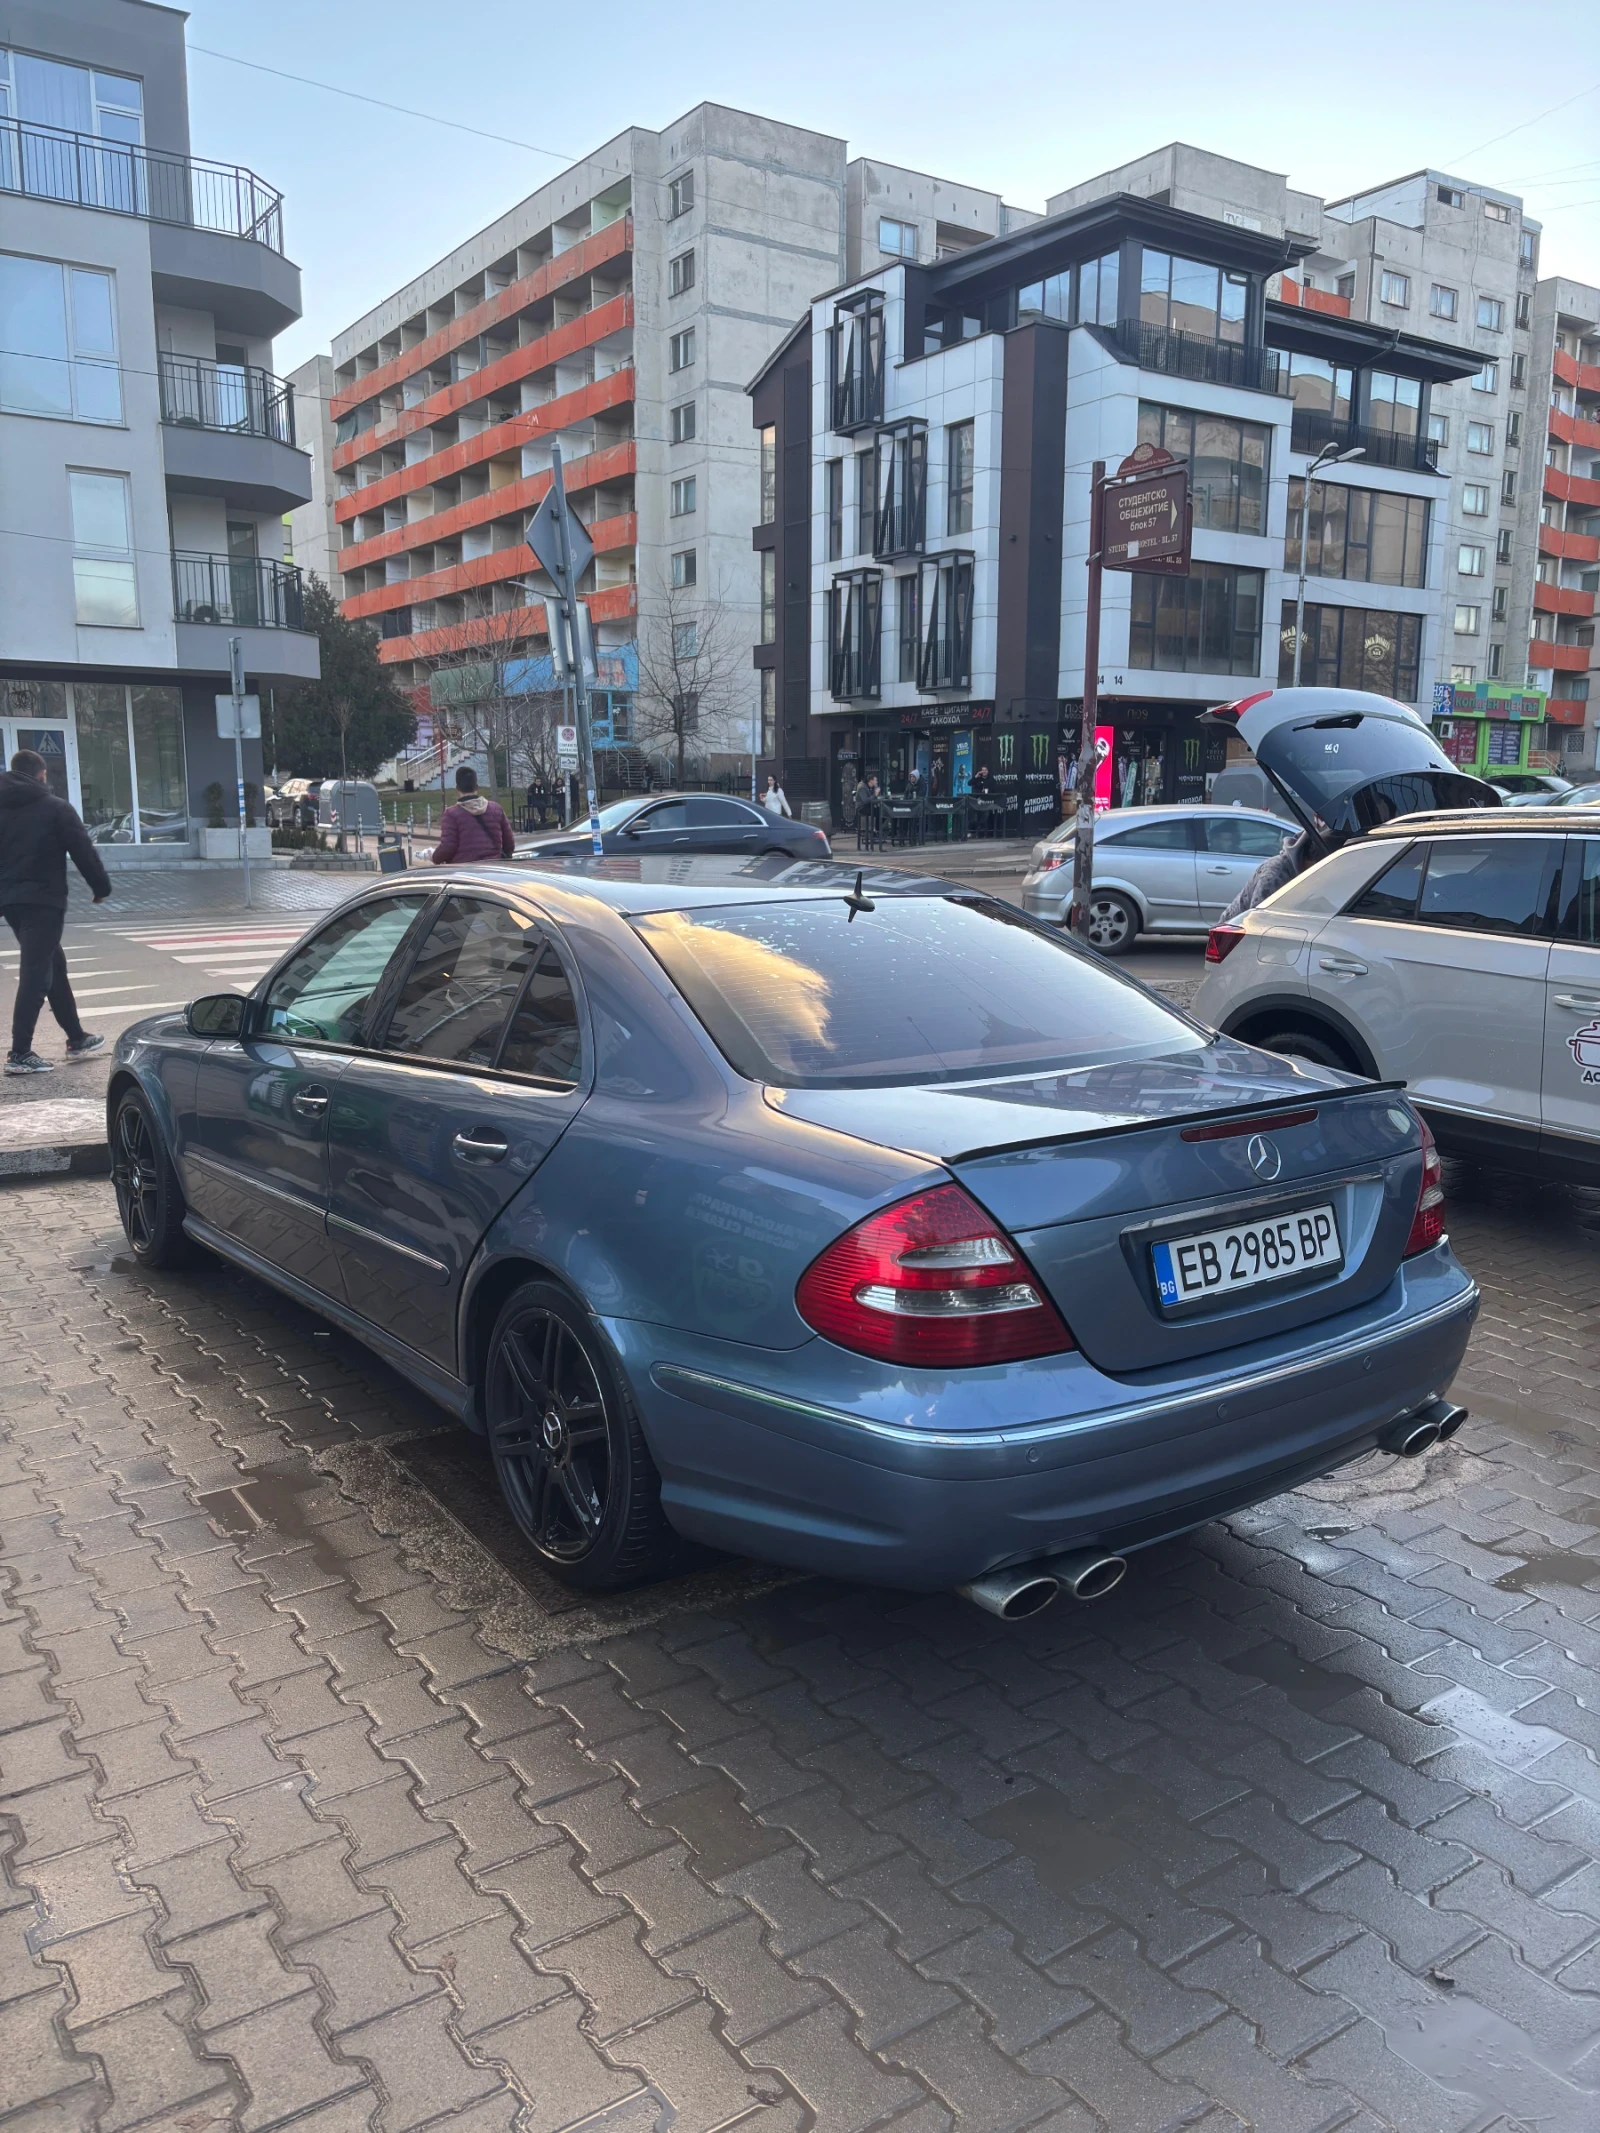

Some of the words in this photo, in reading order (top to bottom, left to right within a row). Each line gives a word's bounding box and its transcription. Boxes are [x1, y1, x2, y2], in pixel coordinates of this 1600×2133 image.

[1118, 488, 1167, 508] СТУДЕНТСКО
[1119, 501, 1169, 520] ОБЩЕЖИТИЕ
[1130, 520, 1147, 531] блок
[1148, 517, 1157, 528] 57
[1108, 543, 1128, 554] STUDEN
[1138, 539, 1158, 549] OSTEL
[1114, 675, 1123, 685] 14
[921, 707, 939, 716] КАФЕ
[944, 705, 969, 715] ЦИГАРИ
[1455, 696, 1499, 710] КОПИРЕН
[1504, 700, 1539, 713] ЦЕНТЪР
[901, 713, 918, 724] 24/7
[971, 707, 991, 719] 24/7
[930, 716, 961, 726] АЛКОХОЛ
[993, 773, 1019, 782] MONSTER
[1025, 773, 1054, 781] MONSTER
[1024, 795, 1054, 807] АЛКОХОЛ
[1030, 803, 1054, 814] ЦИГАРИ
[1176, 1241, 1222, 1292] EB
[1225, 1222, 1296, 1281] 2985
[1297, 1214, 1331, 1261] BP
[1160, 1281, 1175, 1296] BG
